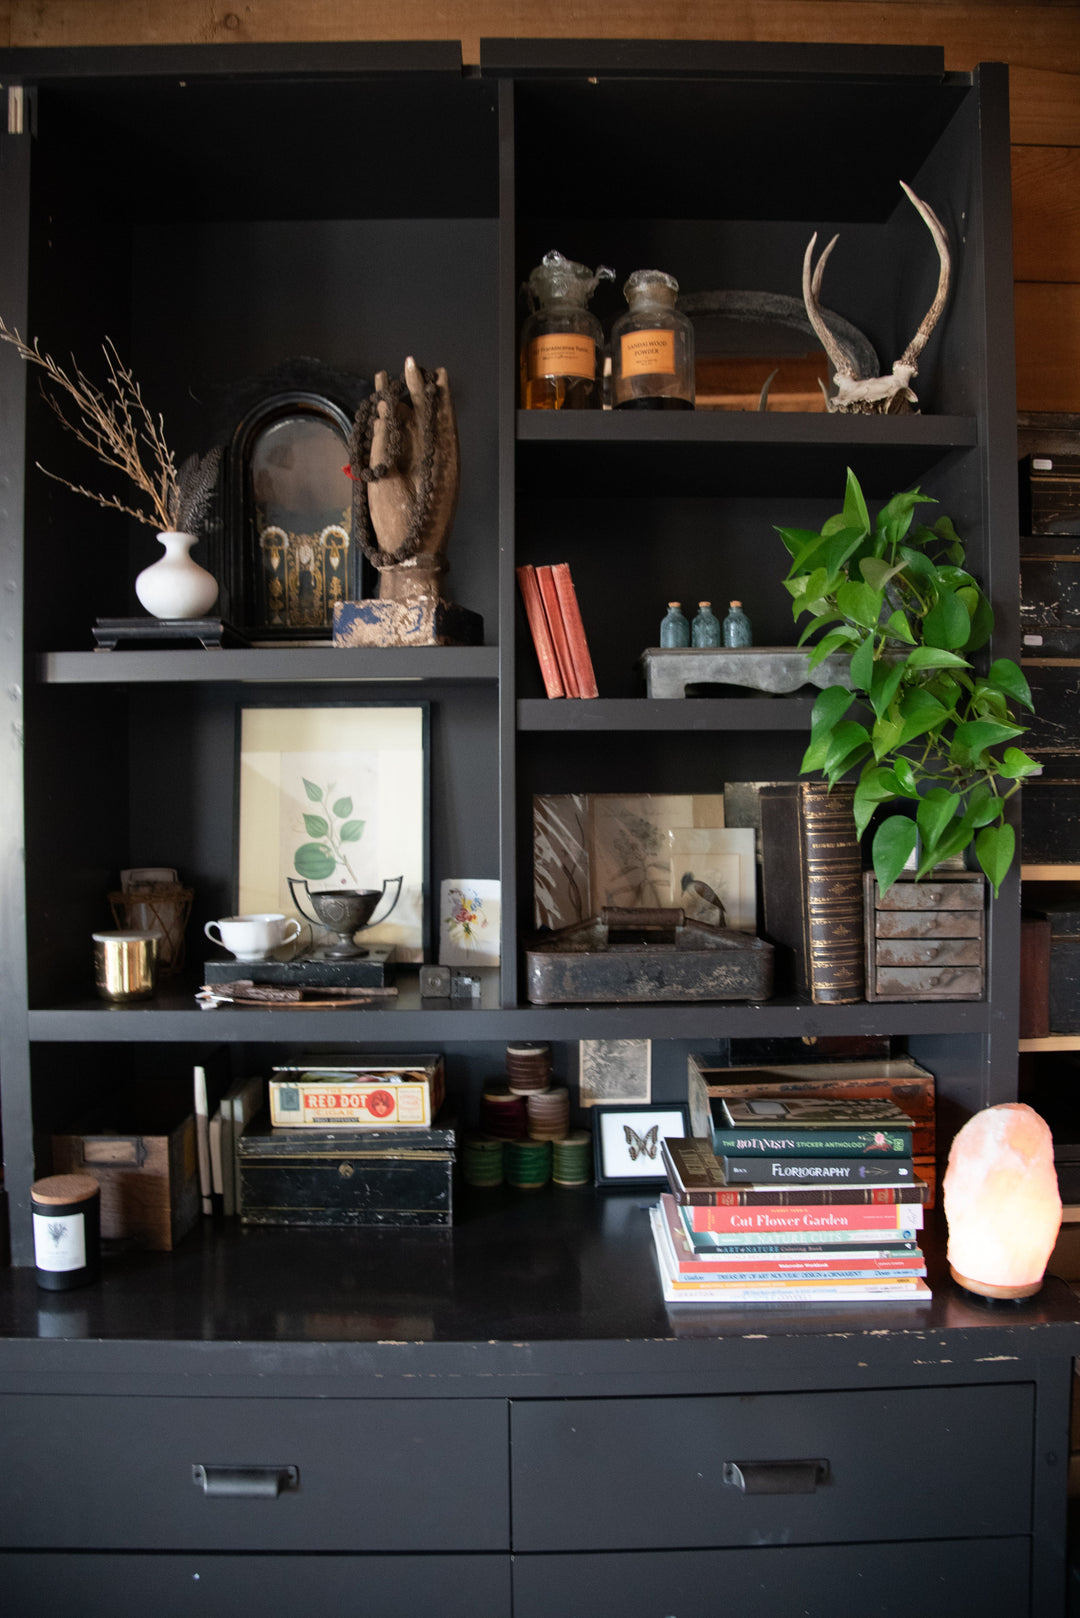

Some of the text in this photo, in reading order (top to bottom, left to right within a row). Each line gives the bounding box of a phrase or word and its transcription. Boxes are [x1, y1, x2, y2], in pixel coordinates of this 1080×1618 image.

[308, 1095, 368, 1108] RED DOT
[722, 1140, 735, 1148] THE
[730, 1213, 849, 1226] Cut Flower Garden
[757, 1231, 806, 1244] NATURE
[811, 1230, 841, 1243] CUTS
